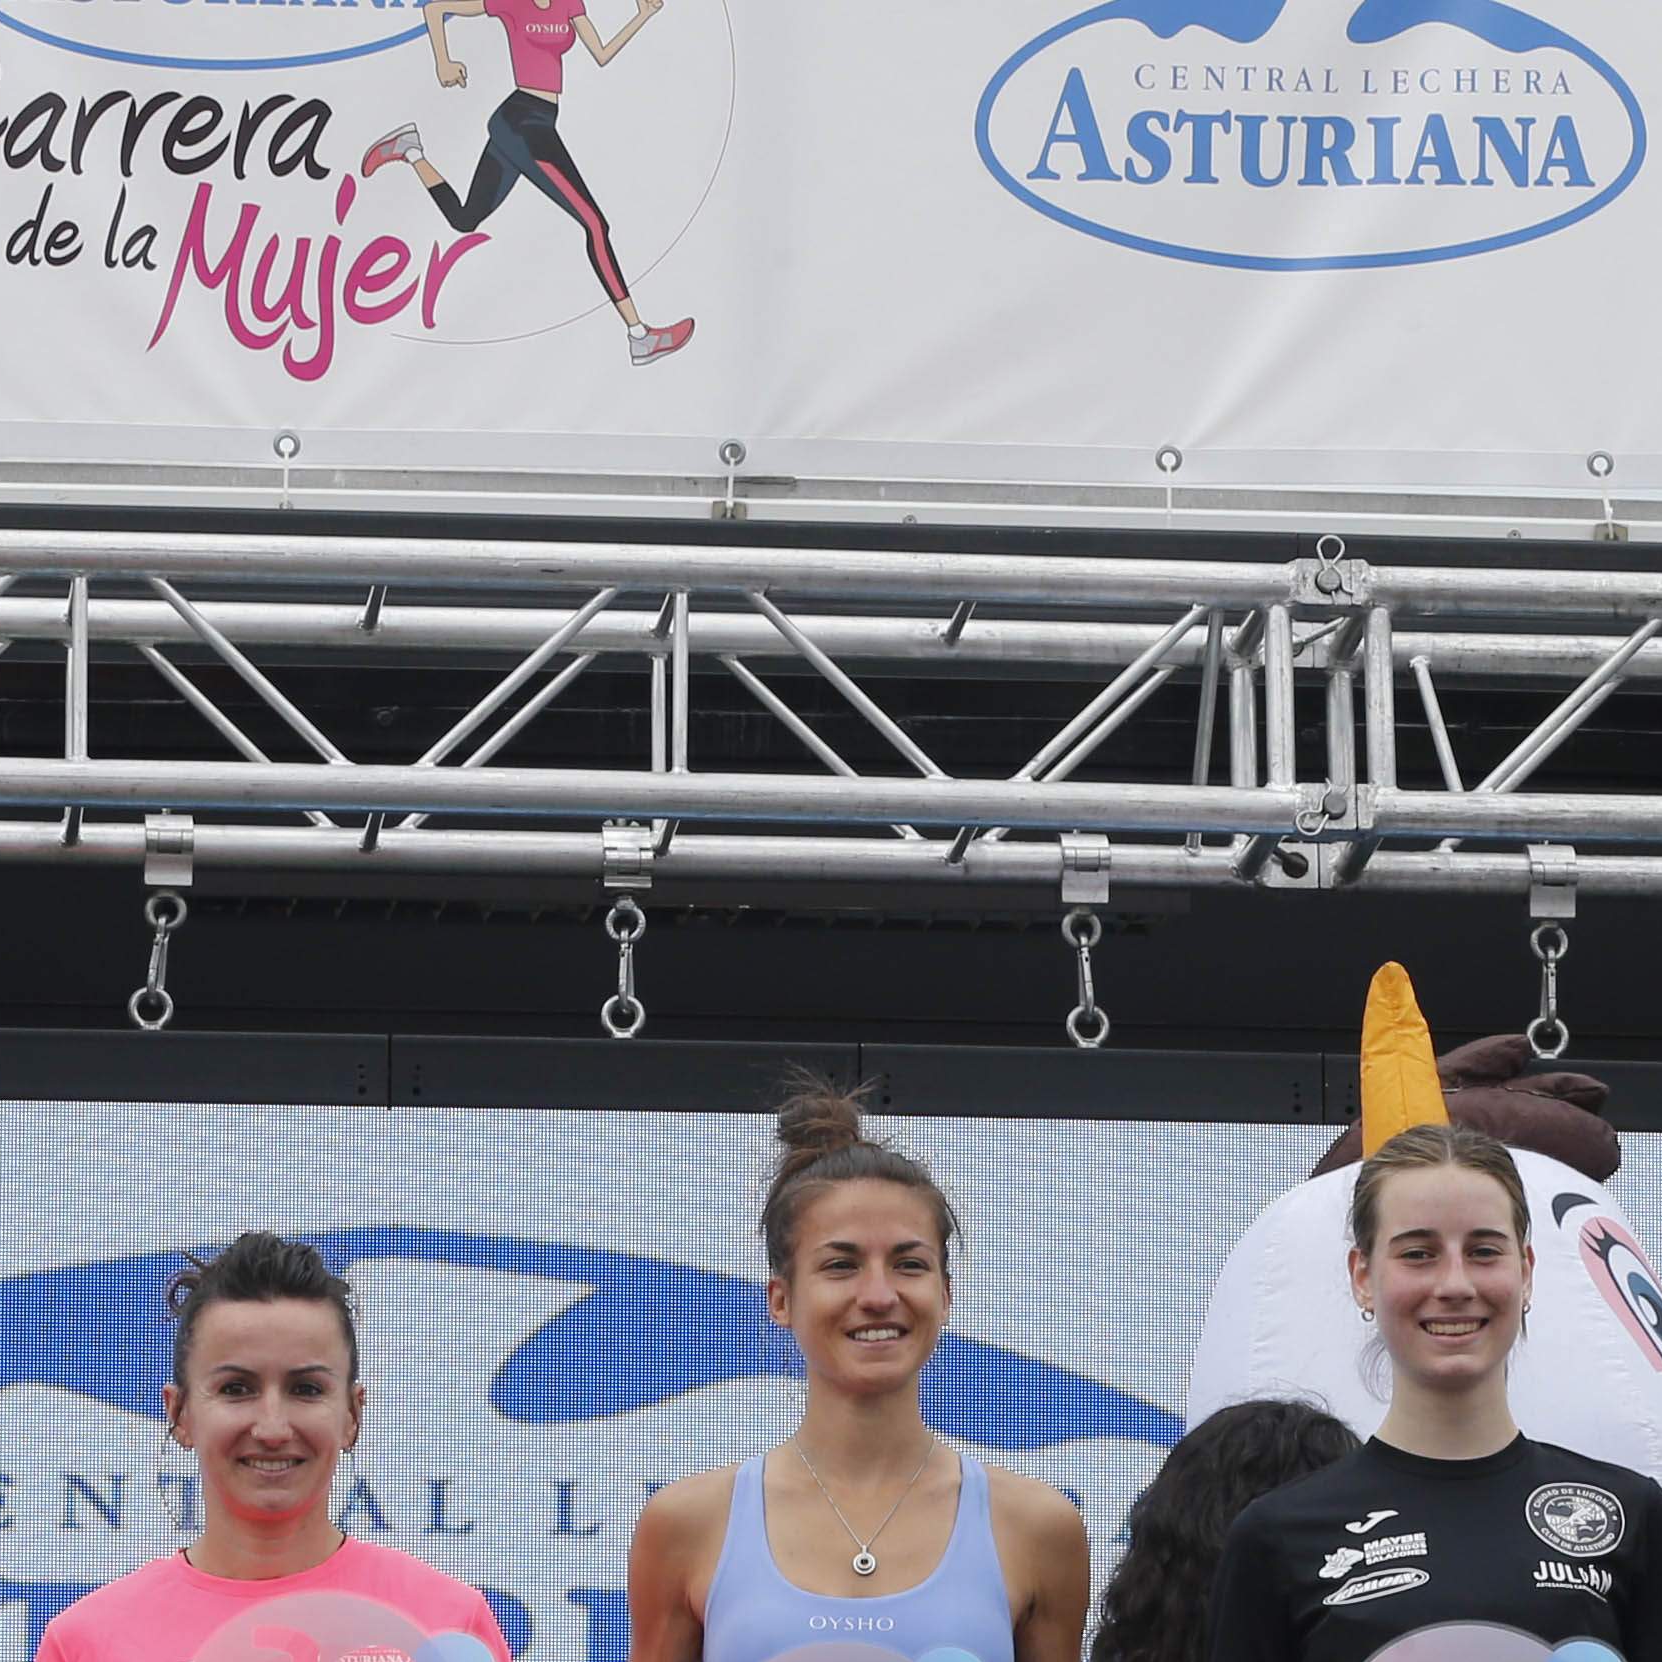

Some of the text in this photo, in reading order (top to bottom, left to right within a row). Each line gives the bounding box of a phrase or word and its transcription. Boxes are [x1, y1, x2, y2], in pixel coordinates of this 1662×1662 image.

[525, 23, 569, 34] OYSHO
[1134, 63, 1573, 97] CENTRAL LECHERA
[1026, 66, 1595, 189] ASTURIANA
[5, 173, 493, 382] de la Mujer
[1577, 1489, 1616, 1512] LUGONES
[1561, 1541, 1572, 1550] DE
[809, 1615, 895, 1632] OYSHO
